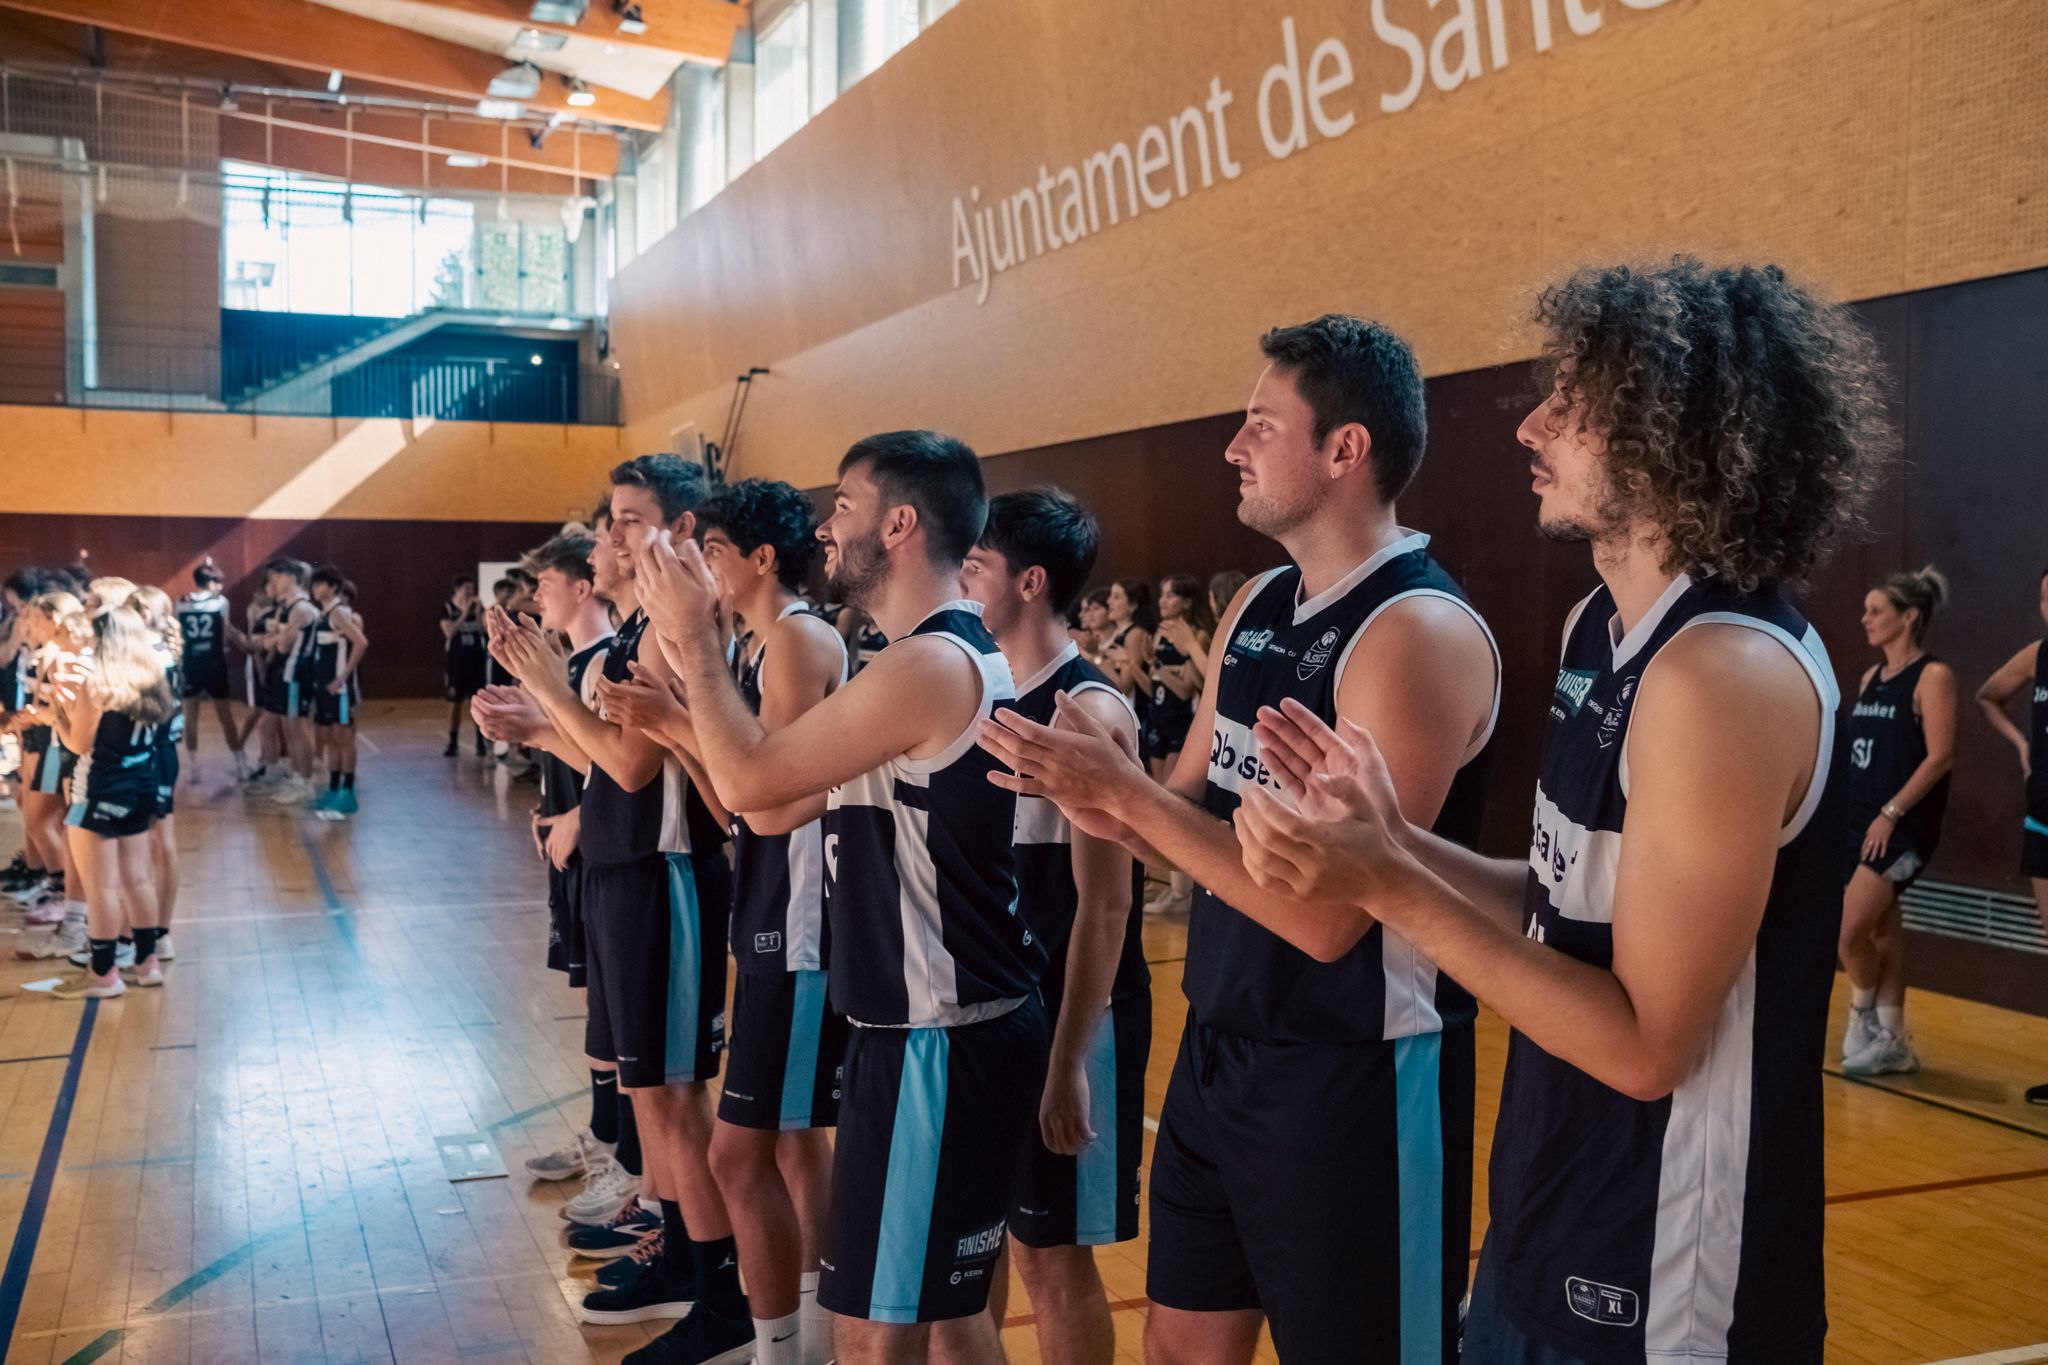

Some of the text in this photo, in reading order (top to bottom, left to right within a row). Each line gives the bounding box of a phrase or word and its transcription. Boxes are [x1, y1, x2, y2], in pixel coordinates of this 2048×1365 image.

[952, 0, 1601, 304] Ajuntament de San
[186, 613, 214, 638] 32
[1155, 685, 1167, 705] 9
[1852, 700, 1896, 719] basket
[1608, 1299, 1623, 1315] XL
